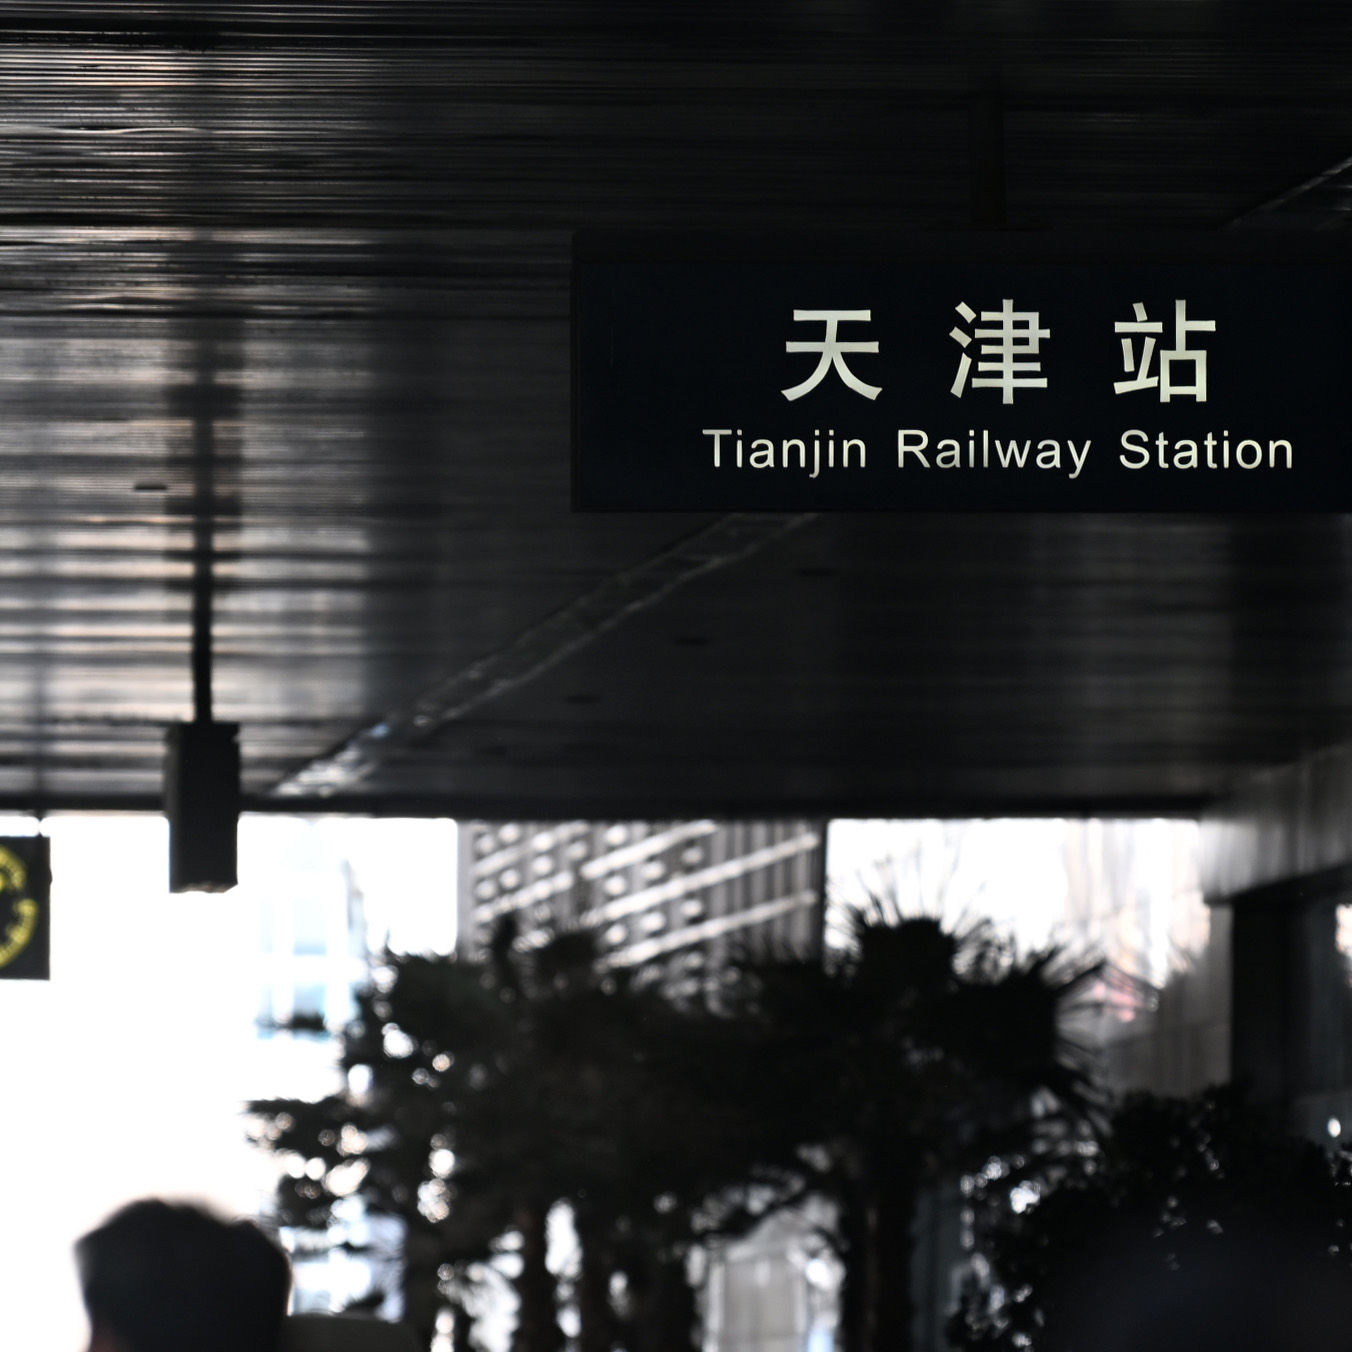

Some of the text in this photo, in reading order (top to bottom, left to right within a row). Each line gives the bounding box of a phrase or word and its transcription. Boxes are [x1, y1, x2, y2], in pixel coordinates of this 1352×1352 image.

[780, 298, 1217, 405] 天津站
[701, 428, 1293, 479] Tianjin Railway Station
